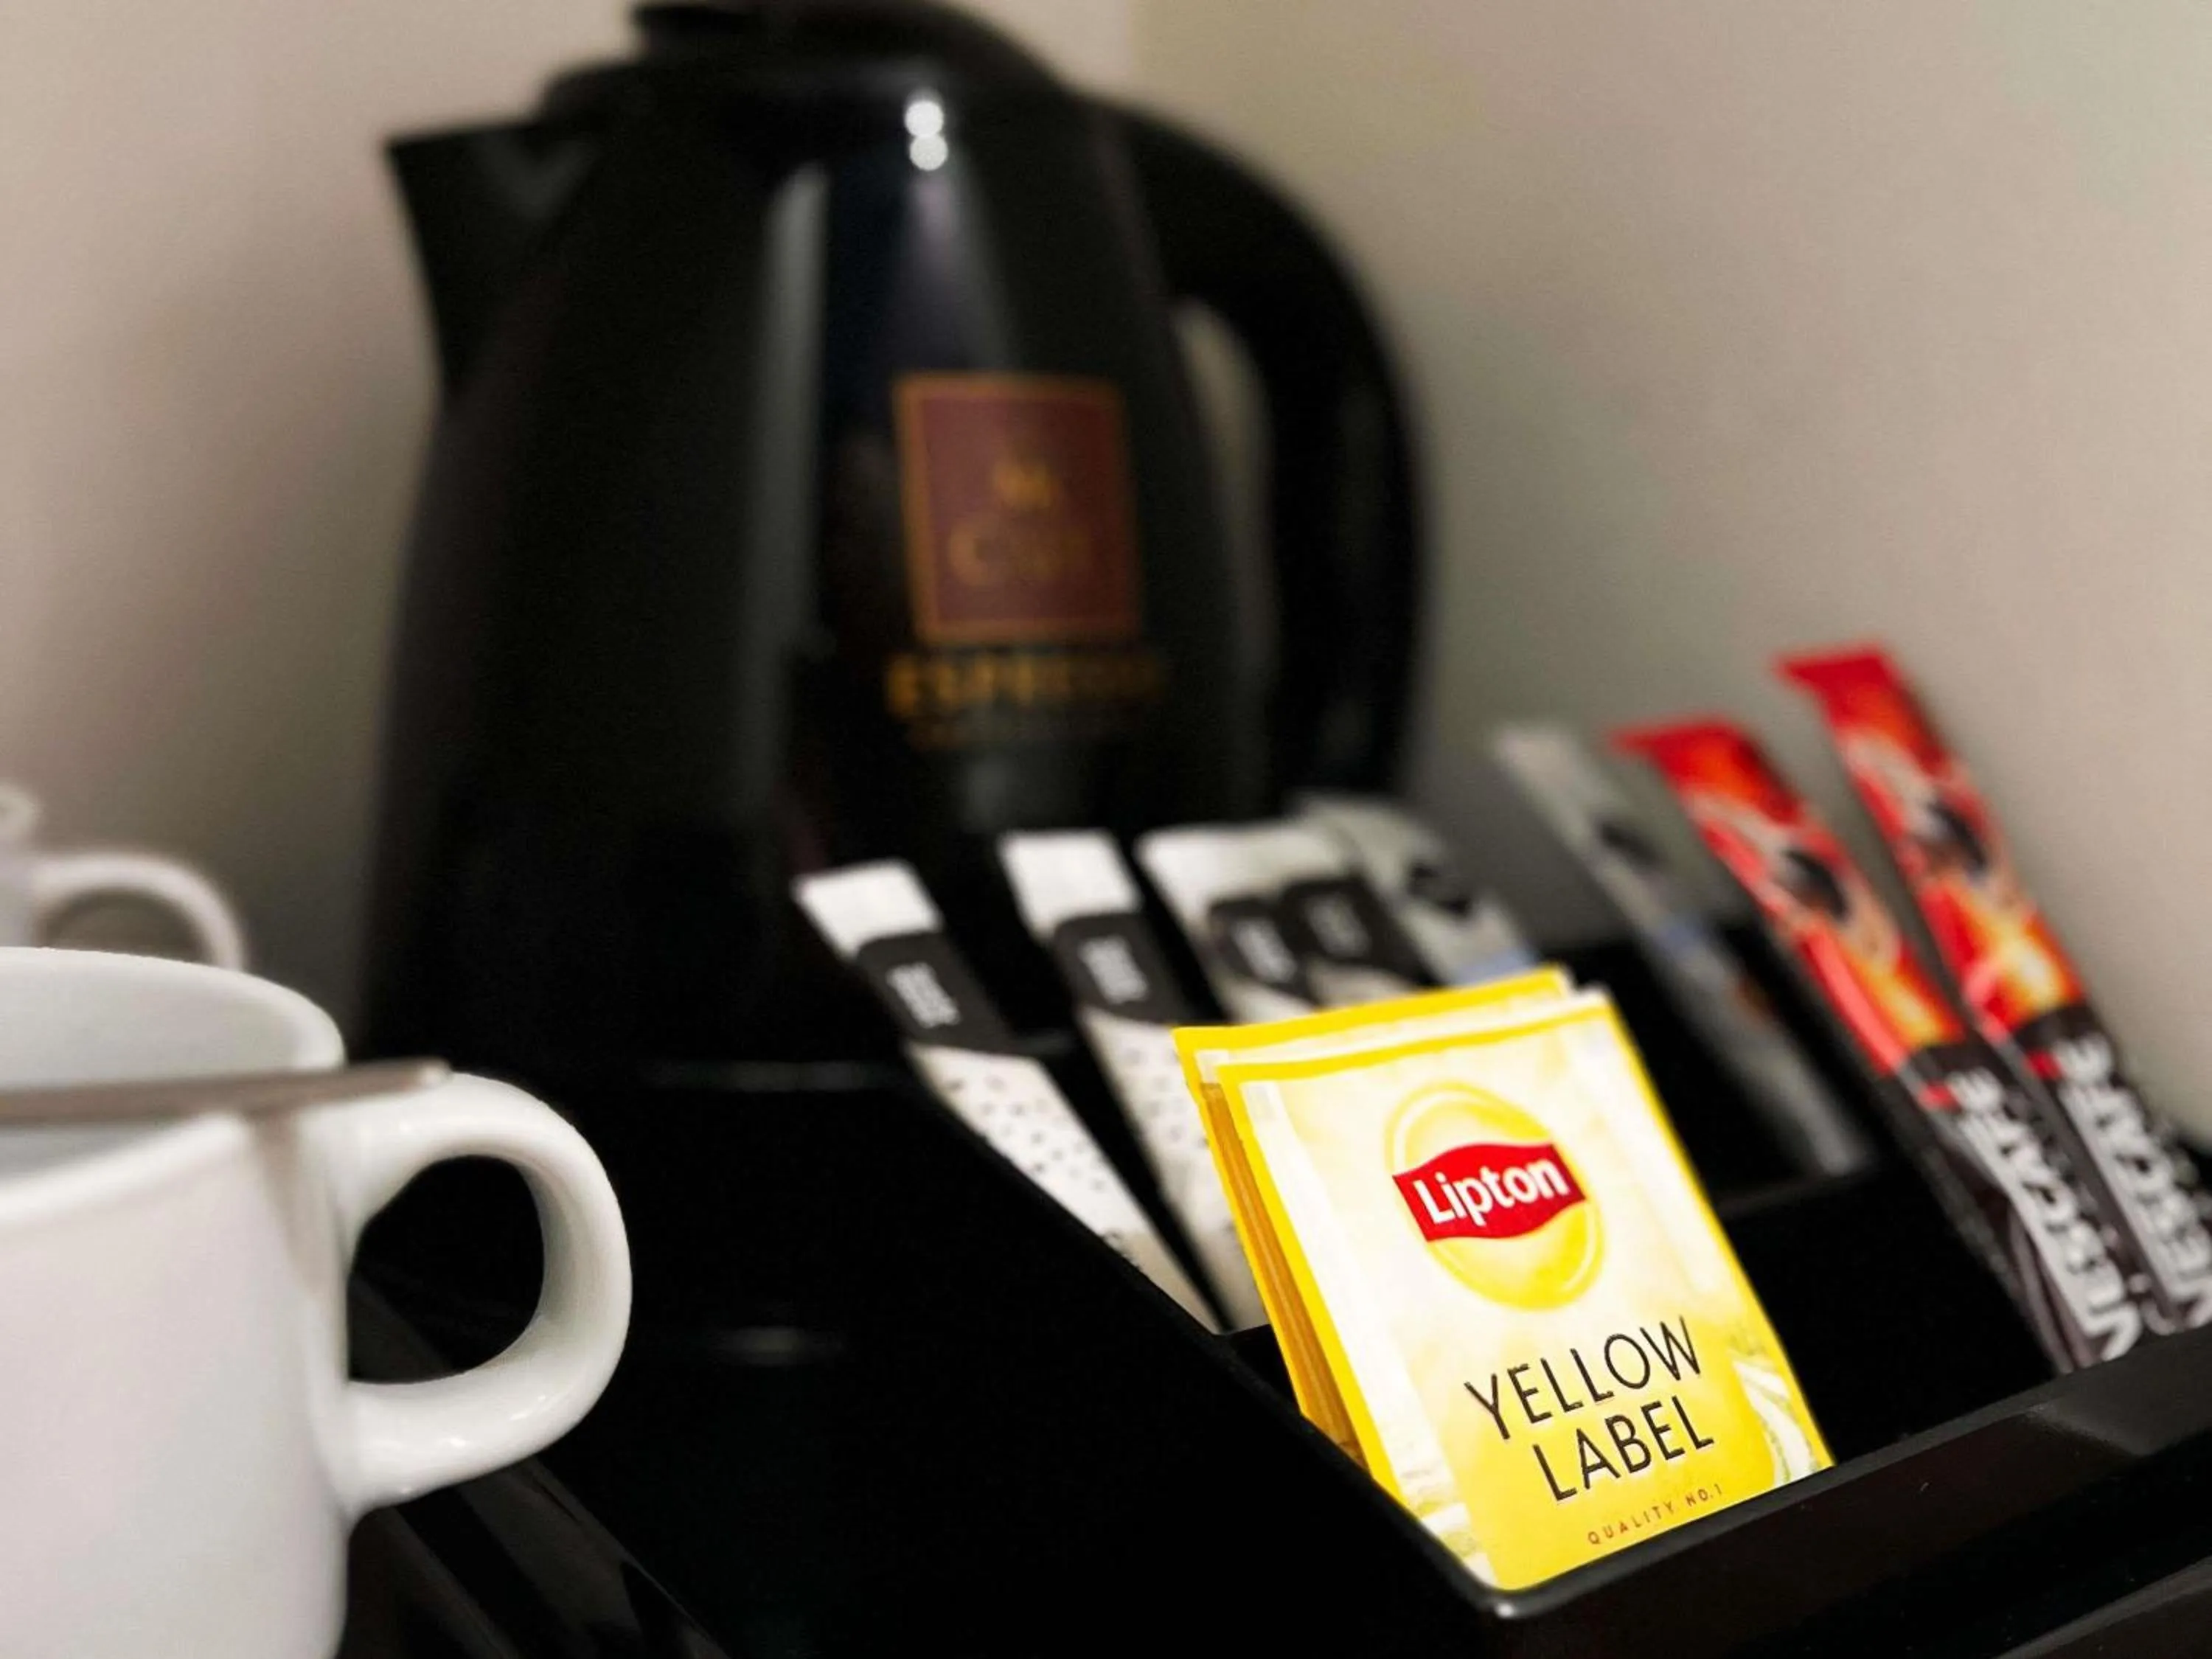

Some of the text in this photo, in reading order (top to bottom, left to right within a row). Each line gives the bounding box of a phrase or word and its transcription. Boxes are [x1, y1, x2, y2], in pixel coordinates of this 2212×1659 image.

[1413, 1158, 1570, 1227] Lipton
[1463, 1317, 1702, 1441] YELLOW
[1532, 1396, 1715, 1503] LABEL
[1587, 1483, 1723, 1545] QUALITY NO.1
